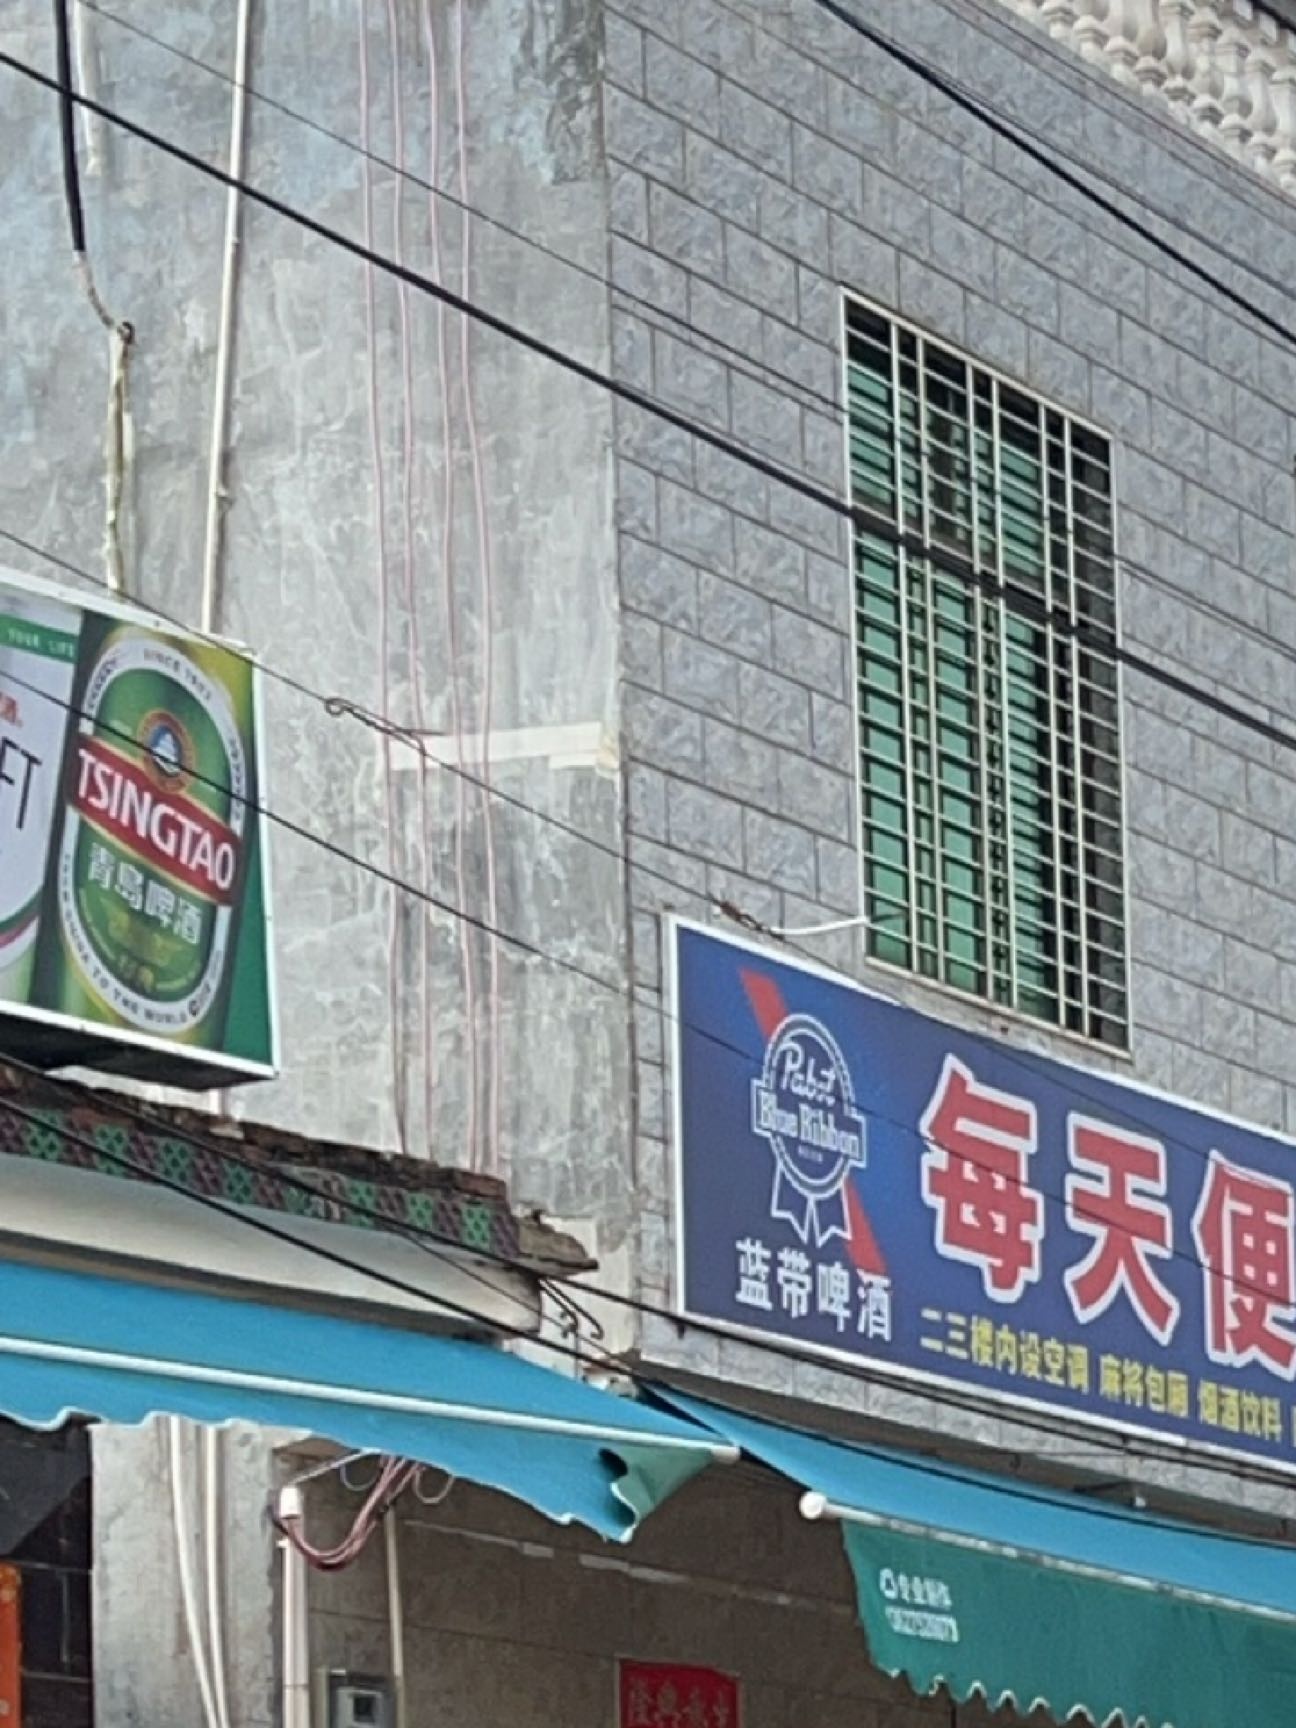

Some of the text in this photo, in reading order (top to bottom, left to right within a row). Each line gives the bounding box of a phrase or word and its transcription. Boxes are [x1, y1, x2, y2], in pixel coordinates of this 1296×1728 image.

[77, 748, 237, 891] TSINGTAO
[759, 1089, 860, 1161] Blue Ribbon
[735, 1237, 892, 1342] 蓝带啤酒
